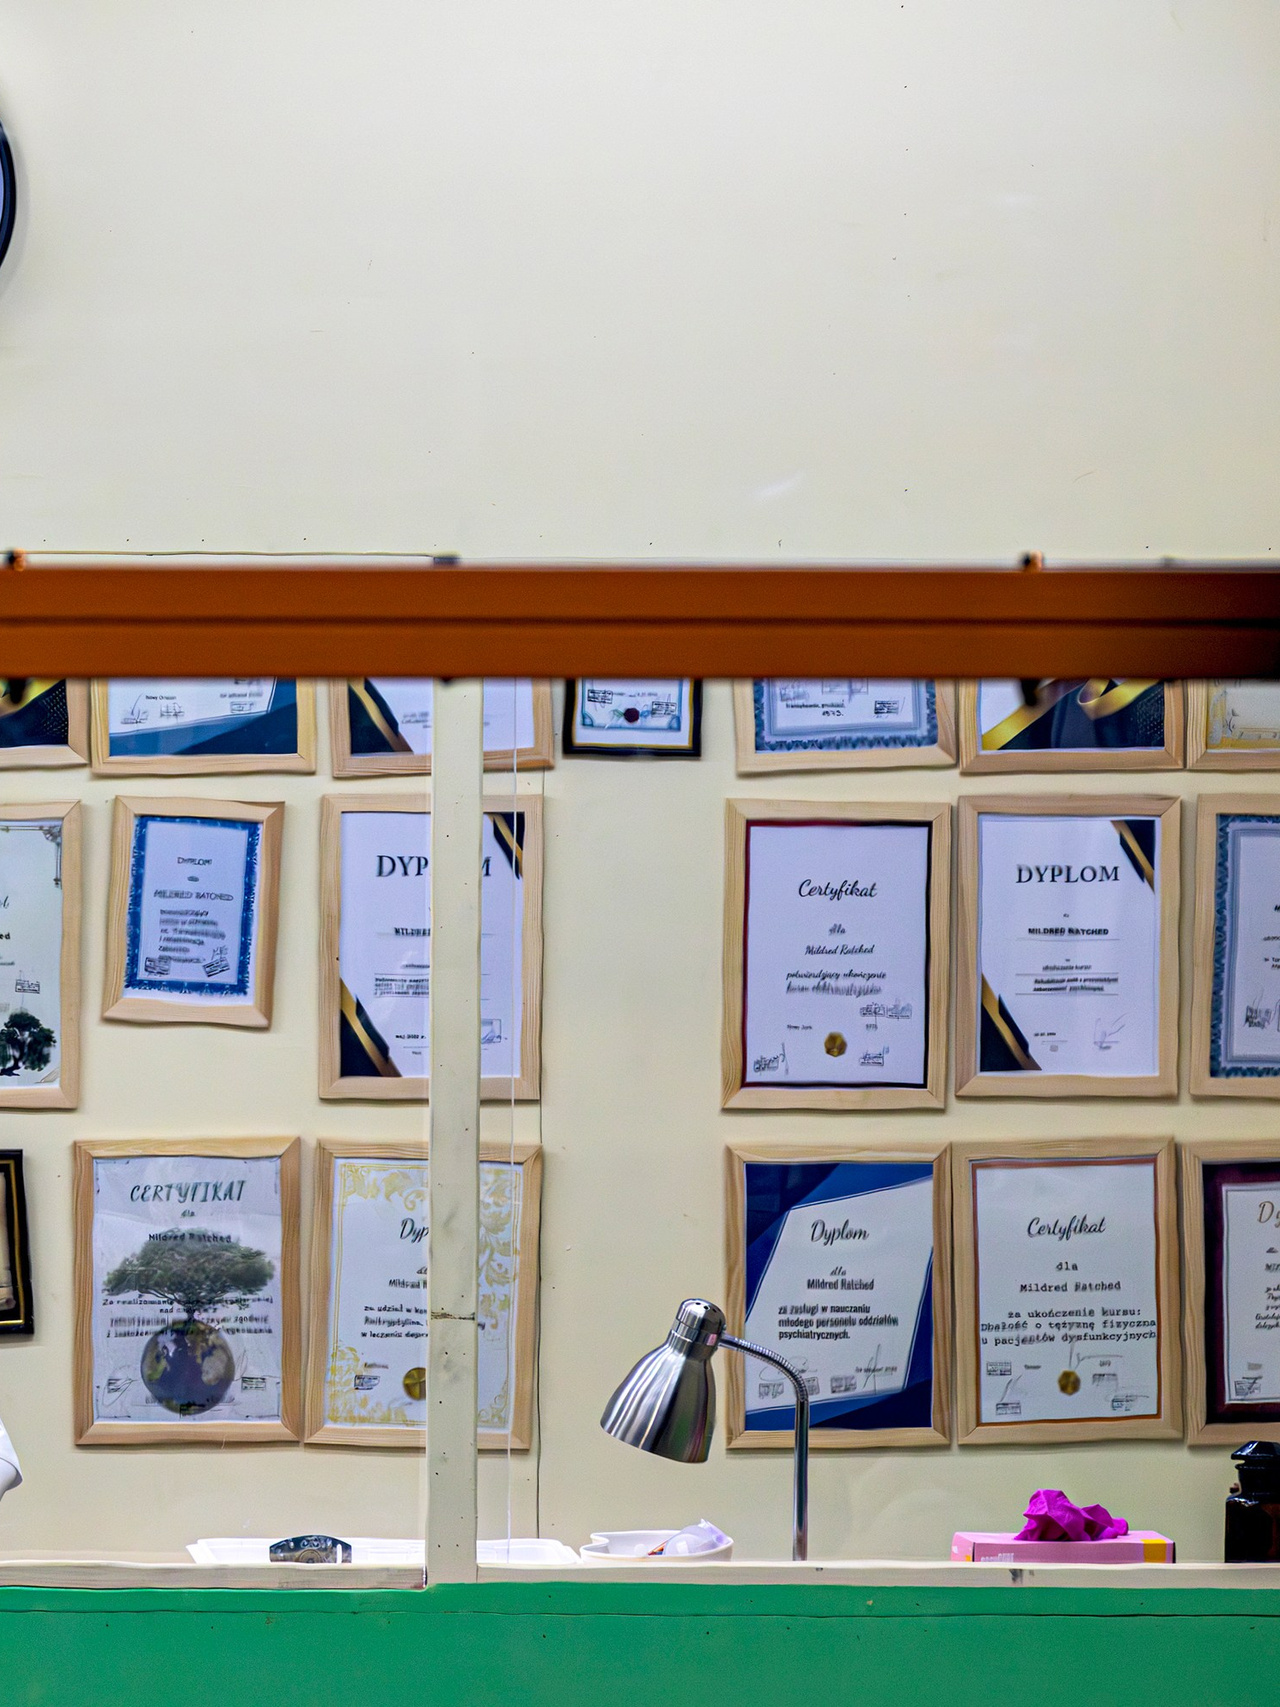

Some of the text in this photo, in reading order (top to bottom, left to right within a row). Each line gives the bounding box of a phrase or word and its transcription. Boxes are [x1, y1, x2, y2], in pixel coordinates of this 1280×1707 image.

[1016, 865, 1121, 884] DYPLOM
[798, 878, 878, 900] Certyfikat
[1028, 928, 1109, 936] MILDRED RATCHED
[805, 944, 874, 955] Mildred Ratched
[130, 1180, 246, 1204] CERTYFIKAT
[181, 1208, 195, 1218] dla
[400, 1218, 429, 1243] Dyp
[810, 1218, 870, 1245] Dyplom
[1027, 1214, 1106, 1241] Certyfikat
[148, 1232, 185, 1242] Mildred
[830, 1266, 847, 1276] dla
[1055, 1262, 1078, 1271] dla
[388, 1279, 420, 1289] Mildred
[807, 1279, 874, 1291] Mildred Ratched
[1020, 1281, 1121, 1292] Mildred Ratched
[377, 1304, 403, 1312] udział
[790, 1303, 819, 1316] zasługi
[830, 1304, 870, 1313] nauczaniu
[1028, 1308, 1095, 1318] ukończenie
[1101, 1307, 1141, 1317] kursu:
[778, 1315, 899, 1329] młodego personelu oddziałów
[981, 1320, 1028, 1331] Dbałość
[1048, 1320, 1095, 1331] tężyznę
[778, 1329, 850, 1340] psychiatrycznych.
[994, 1332, 1056, 1346] pacjentów
[1061, 1330, 1157, 1344] dysfunkcyjnych
